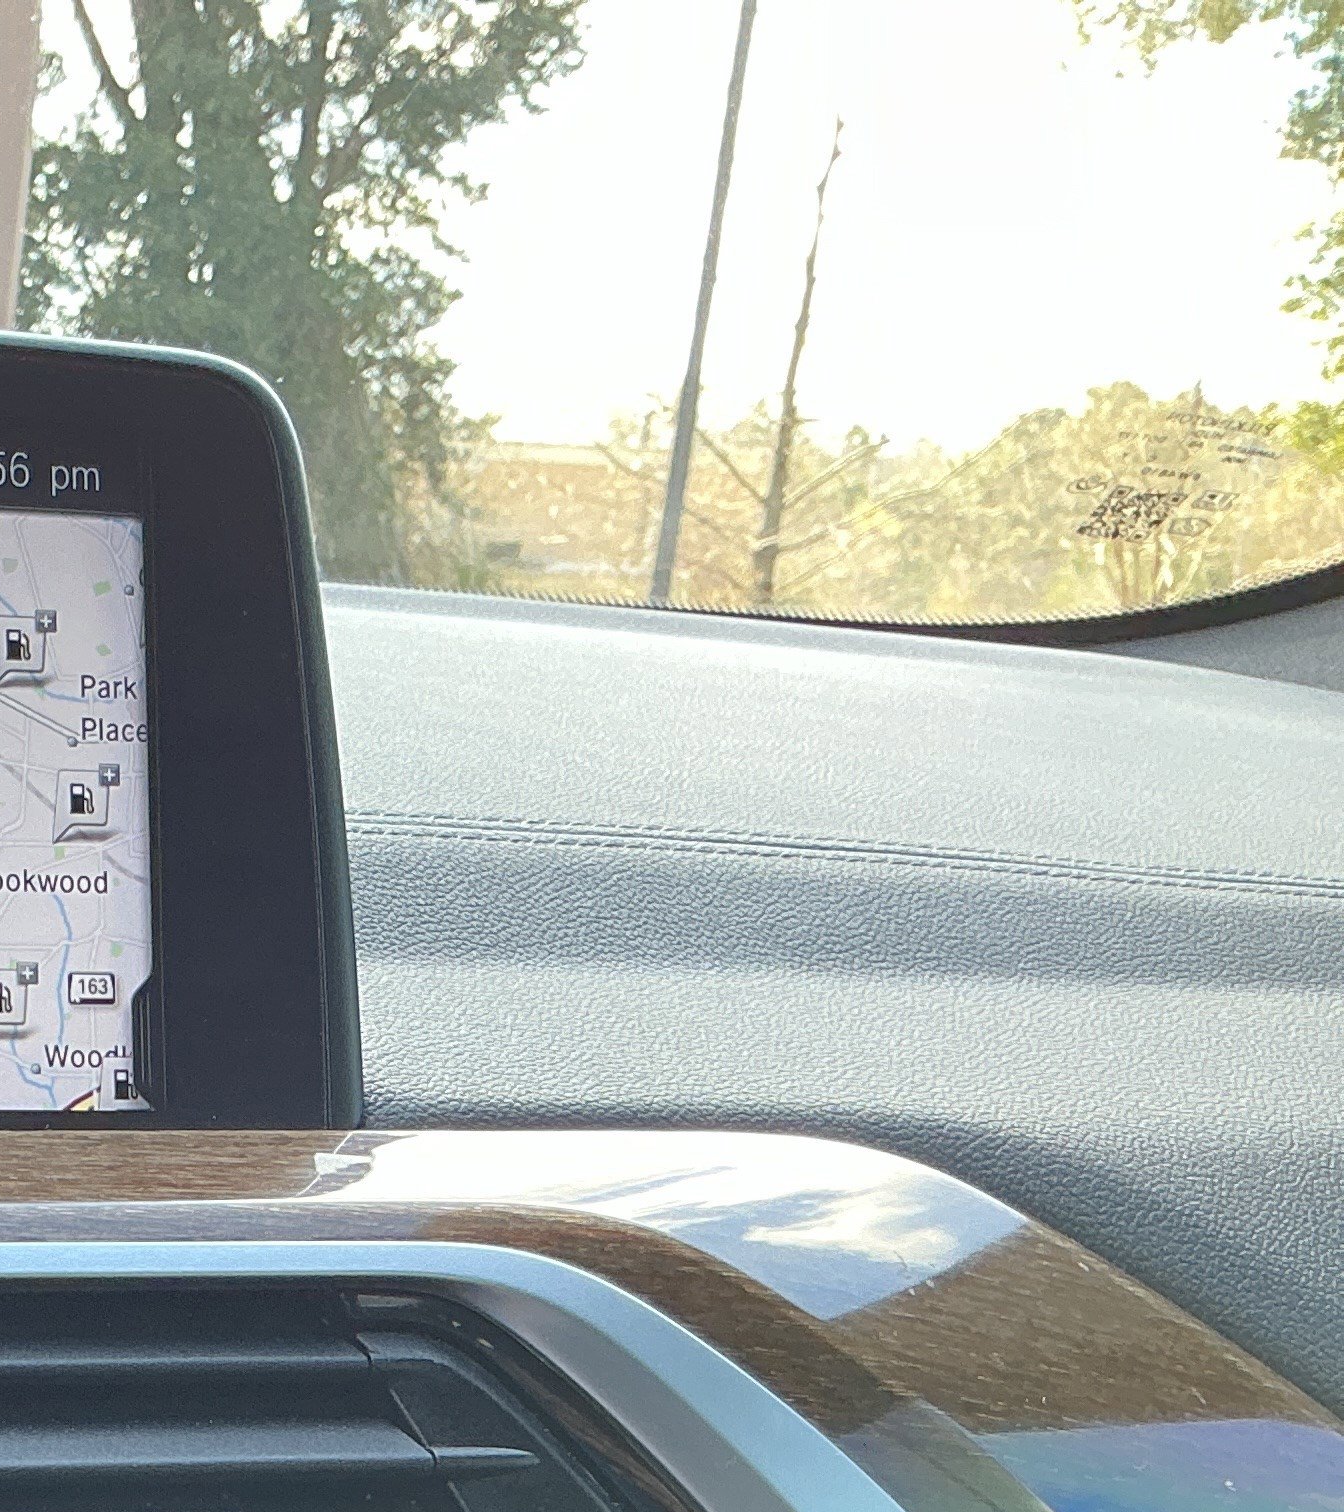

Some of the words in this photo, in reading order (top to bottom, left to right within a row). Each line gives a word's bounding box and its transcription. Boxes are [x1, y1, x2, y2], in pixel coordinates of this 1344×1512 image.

[50, 462, 101, 496] pm
[80, 675, 137, 702] Park
[80, 717, 147, 743] Place
[78, 978, 108, 994] 163
